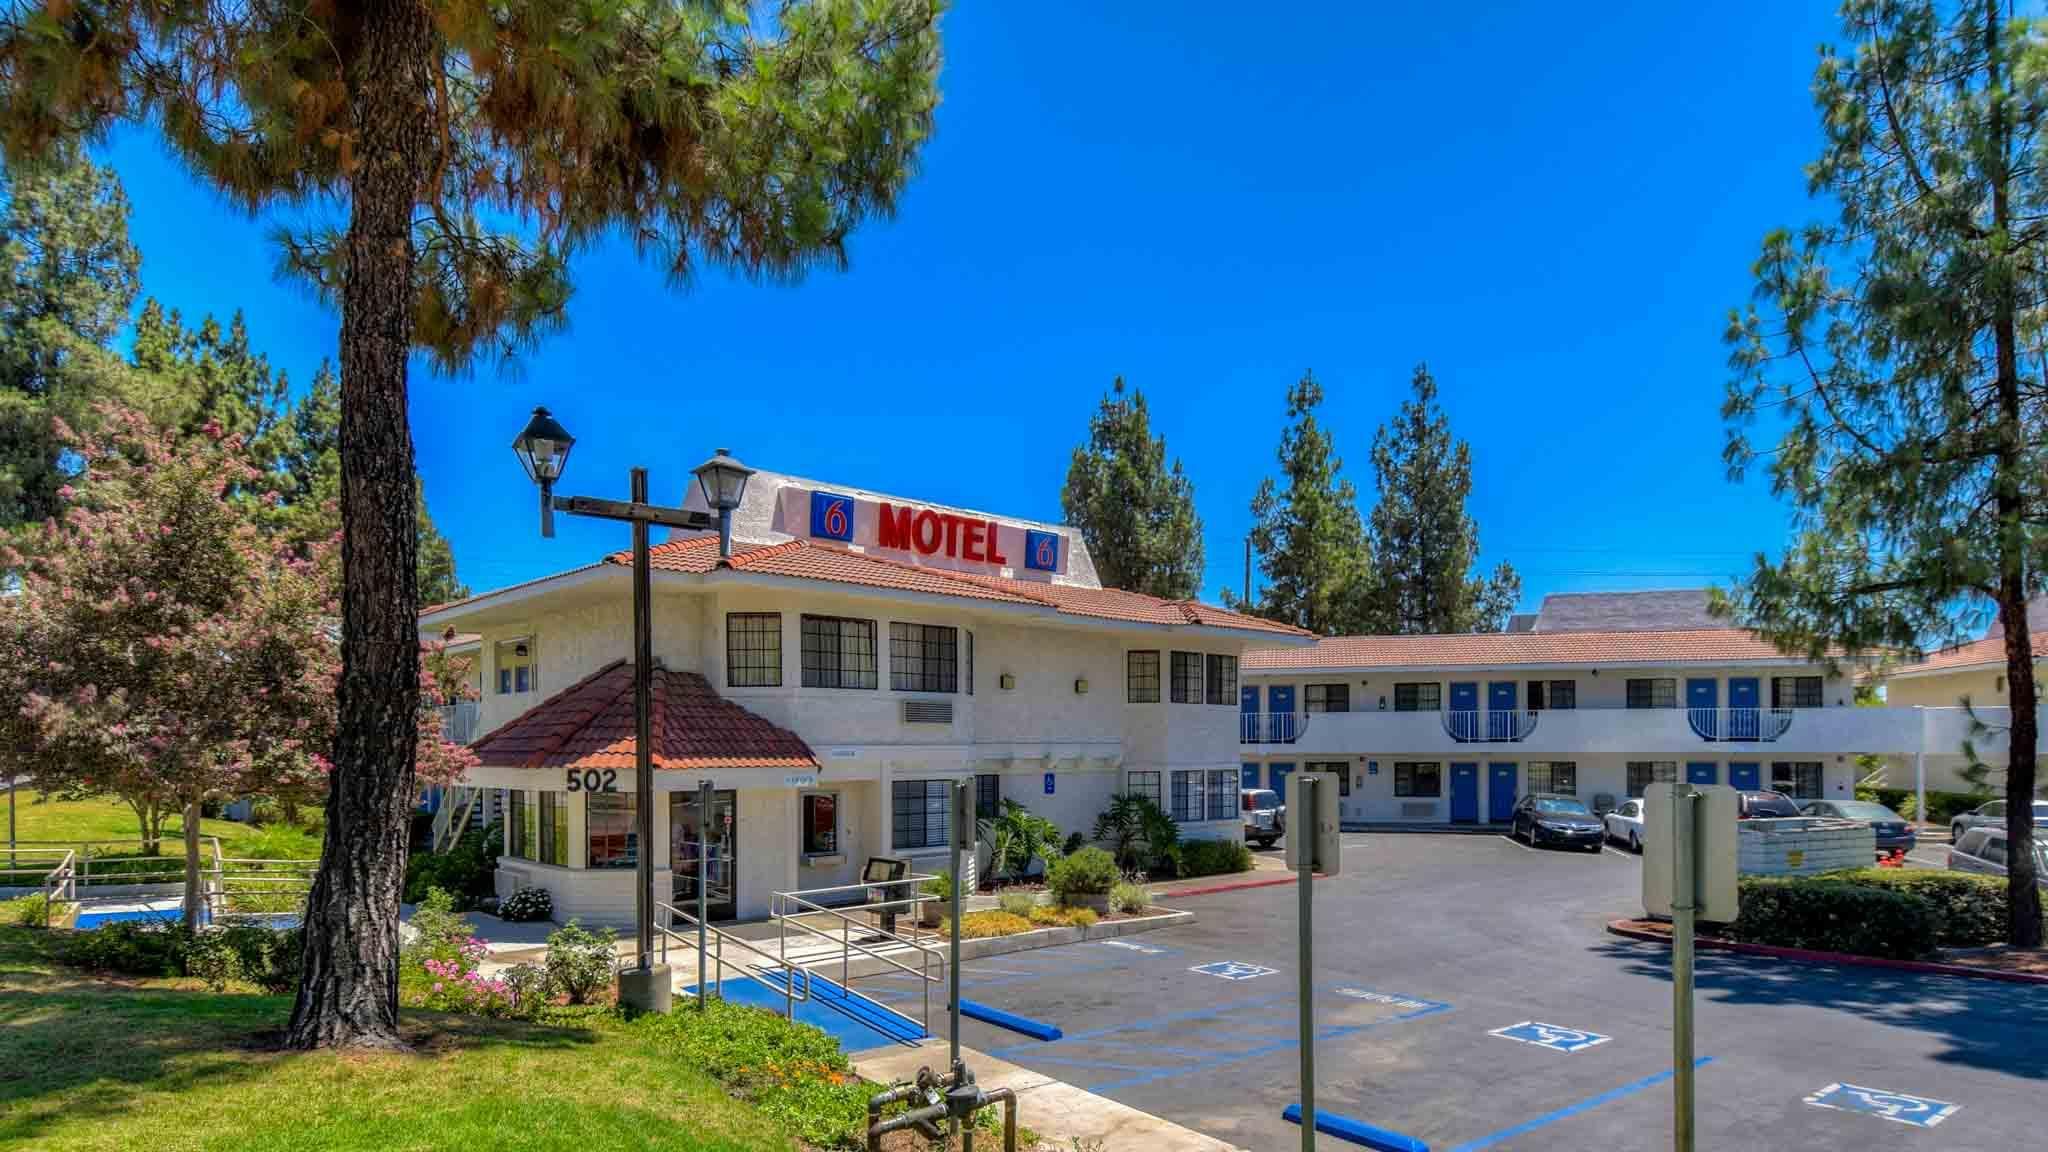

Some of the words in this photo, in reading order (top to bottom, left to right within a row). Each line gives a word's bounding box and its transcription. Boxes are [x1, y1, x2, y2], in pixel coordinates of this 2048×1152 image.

[825, 500, 848, 536] 6
[878, 502, 1007, 565] MOTEL
[1036, 538, 1054, 568] 6
[567, 768, 617, 792] 502
